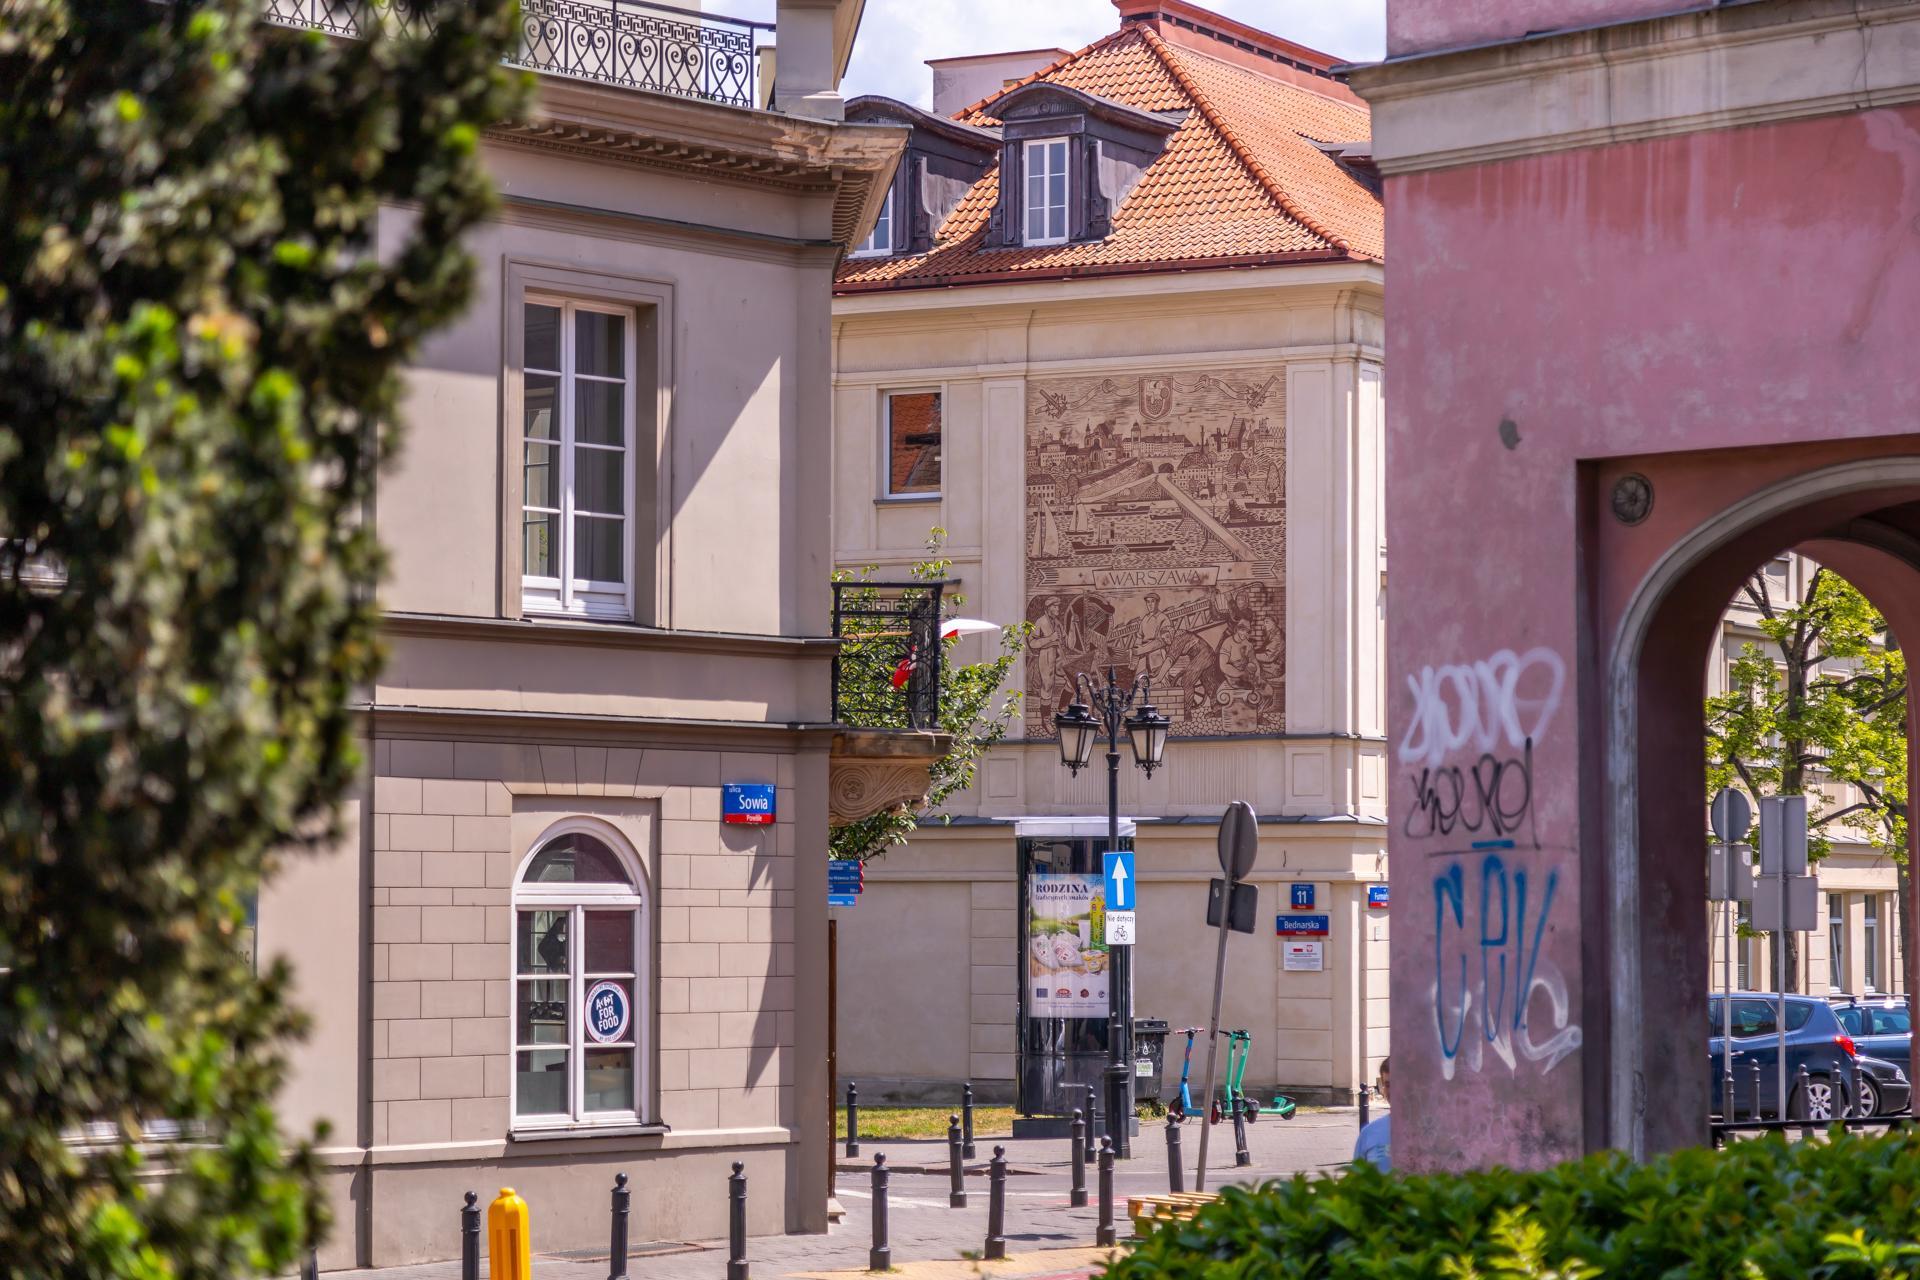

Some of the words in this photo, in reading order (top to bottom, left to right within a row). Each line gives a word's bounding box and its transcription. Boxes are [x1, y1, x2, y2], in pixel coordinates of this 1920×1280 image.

[1109, 570, 1200, 586] WARSZAWA
[739, 795, 768, 810] Sowia
[1036, 884, 1088, 893] RODZINA
[1297, 890, 1307, 904] 11
[1284, 920, 1320, 929] Bednarska
[599, 1005, 615, 1021] FOR
[598, 1015, 619, 1032] FOOD
